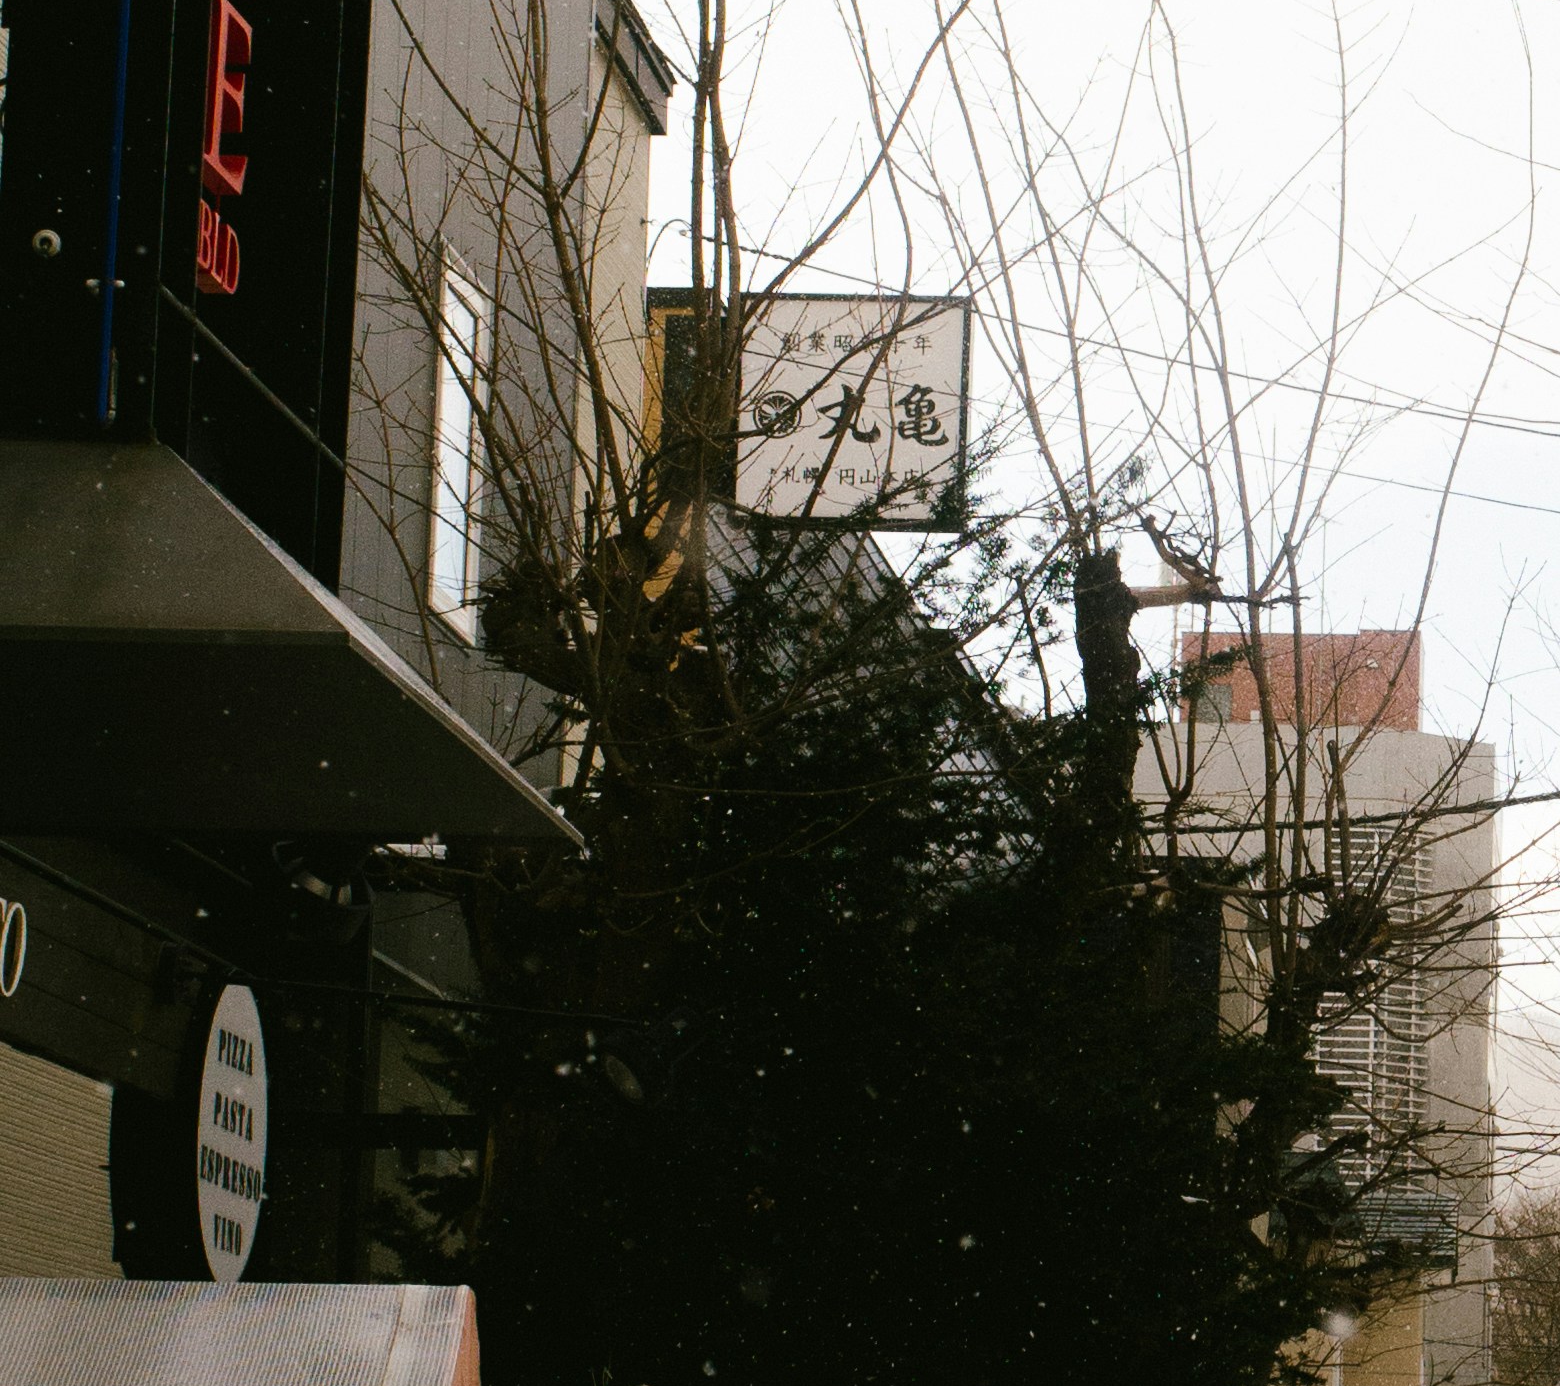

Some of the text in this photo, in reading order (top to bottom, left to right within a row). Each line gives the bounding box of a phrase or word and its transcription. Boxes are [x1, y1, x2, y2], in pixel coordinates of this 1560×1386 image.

[196, 198, 240, 295] BLD
[817, 383, 949, 447] 丸亀
[218, 1028, 253, 1076] PIZZA
[213, 1091, 253, 1142] PASTA
[200, 1144, 262, 1203] ESPRESSO
[213, 1213, 243, 1256] VINO
